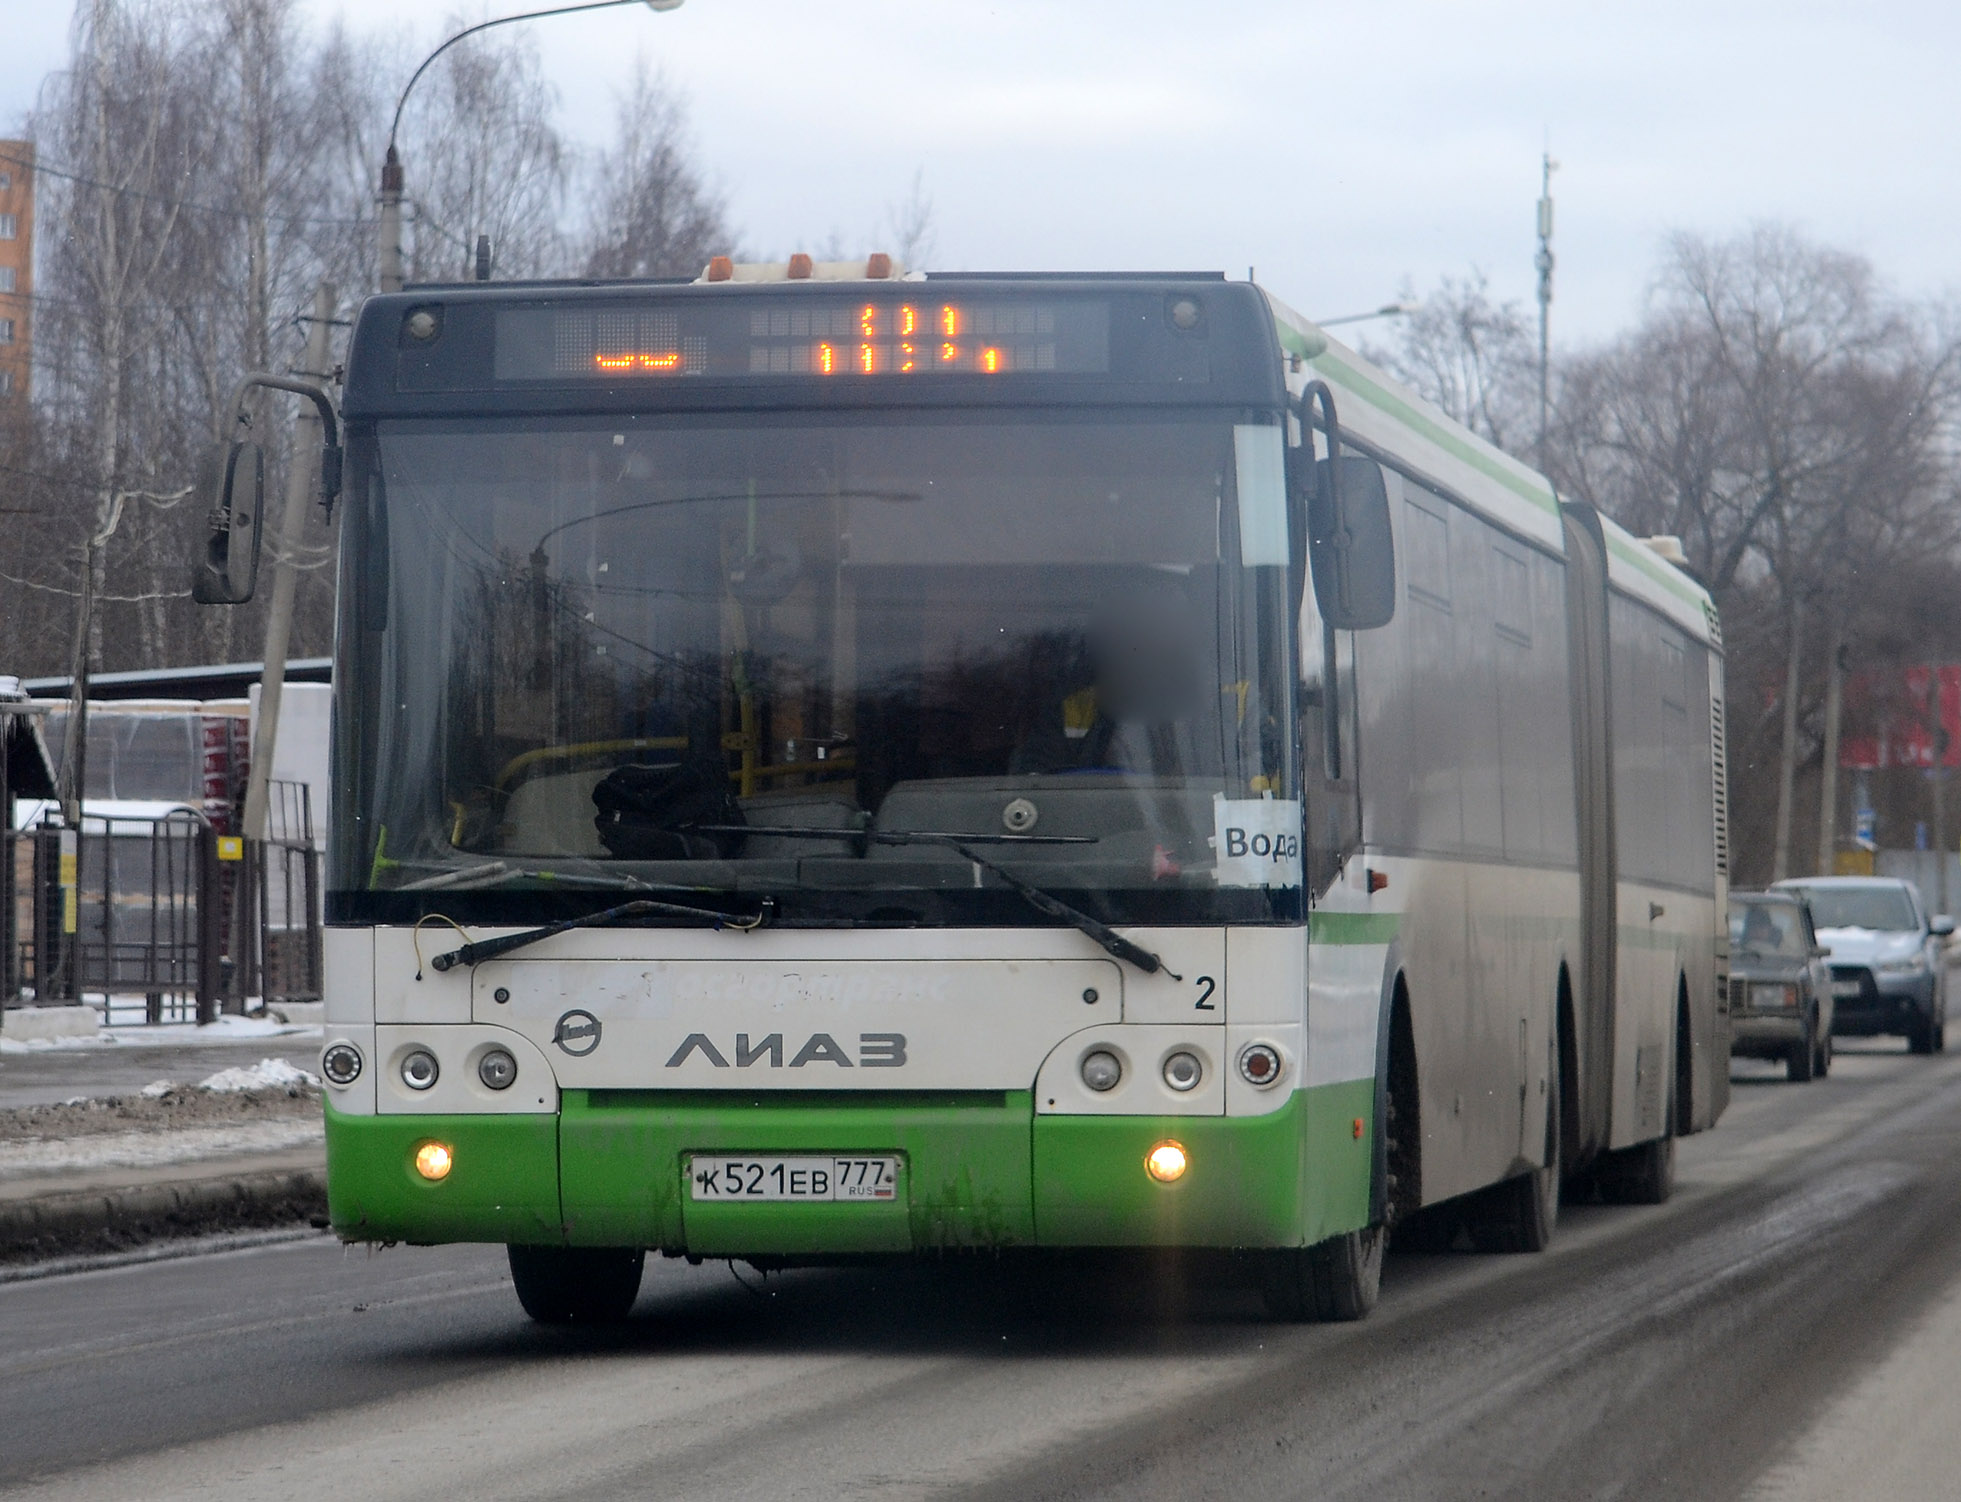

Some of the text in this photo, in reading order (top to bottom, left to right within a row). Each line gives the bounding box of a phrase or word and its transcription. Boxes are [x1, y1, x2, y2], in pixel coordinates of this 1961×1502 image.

[1226, 827, 1298, 863] Вода
[1195, 976, 1215, 1010] 2
[664, 1033, 908, 1067] ЛИАЗ
[703, 1161, 885, 1195] К521ЕВ 777
[849, 1186, 874, 1196] RUS
